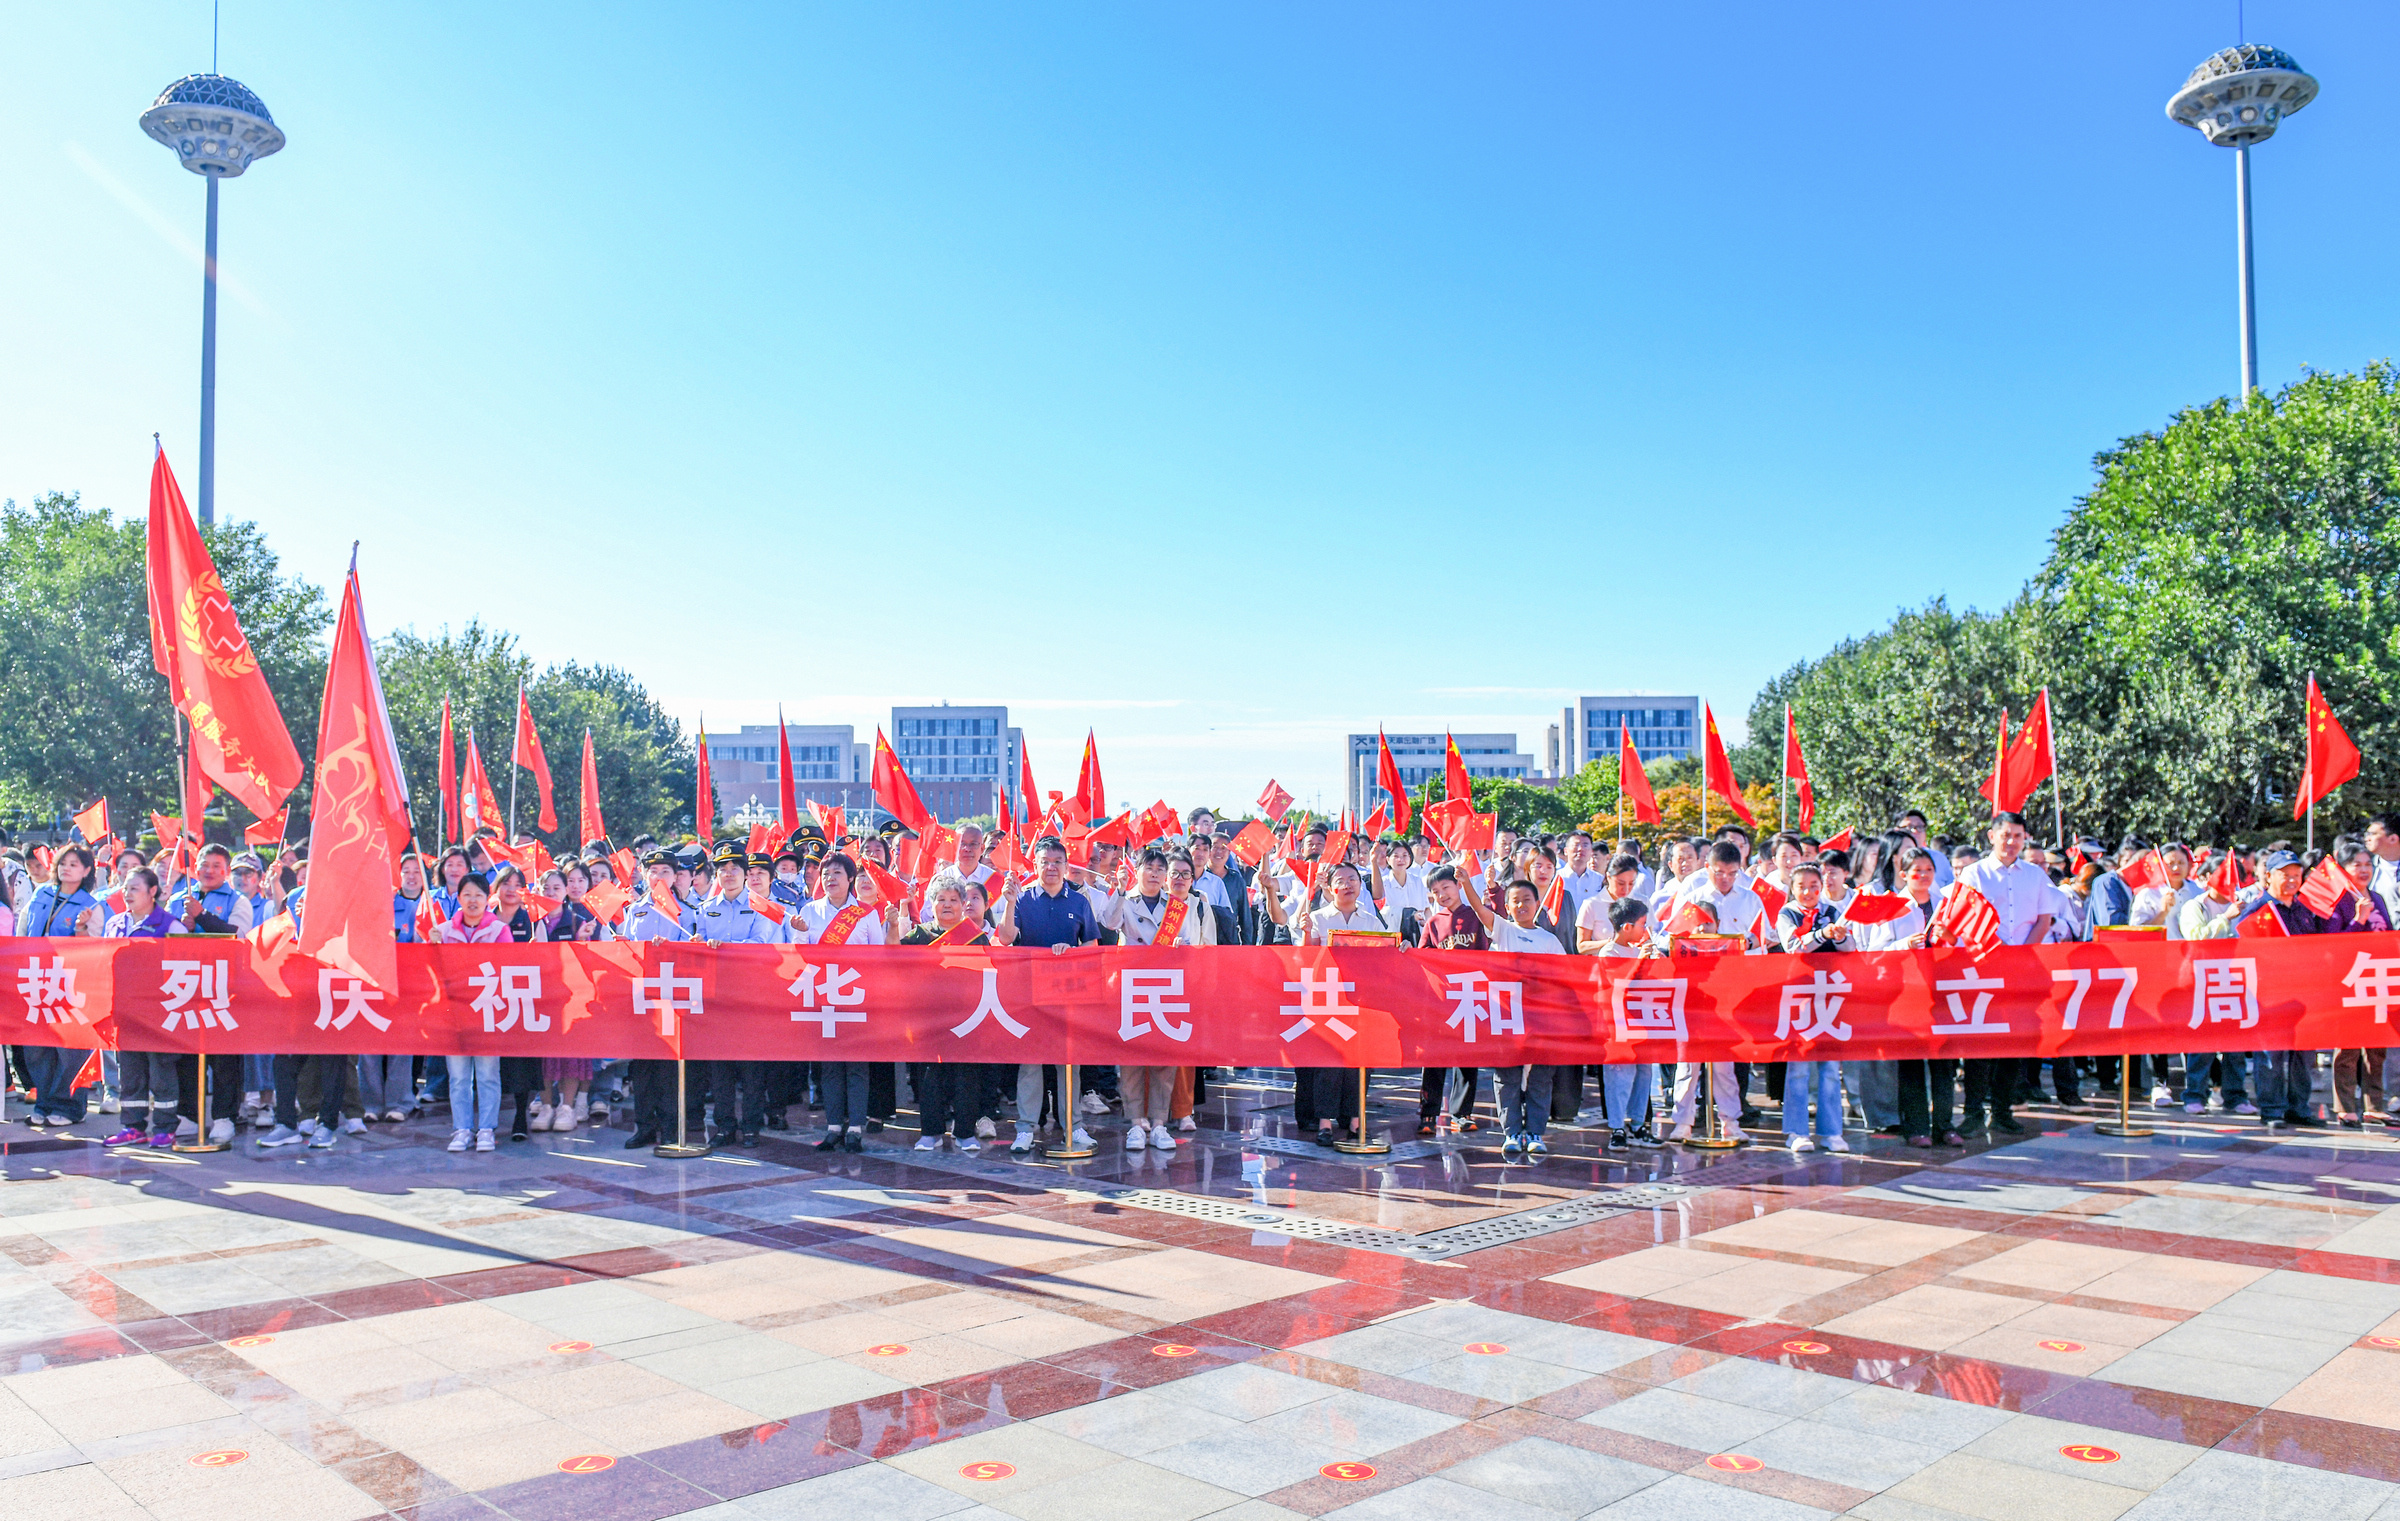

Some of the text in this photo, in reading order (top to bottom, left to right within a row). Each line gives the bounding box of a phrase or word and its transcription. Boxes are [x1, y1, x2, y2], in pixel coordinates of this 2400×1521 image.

[2072, 1447, 2105, 1460] 2
[574, 1457, 597, 1470] 7
[1728, 1457, 1744, 1469] 1
[977, 1464, 998, 1478] 5
[1336, 1464, 1359, 1477] 3
